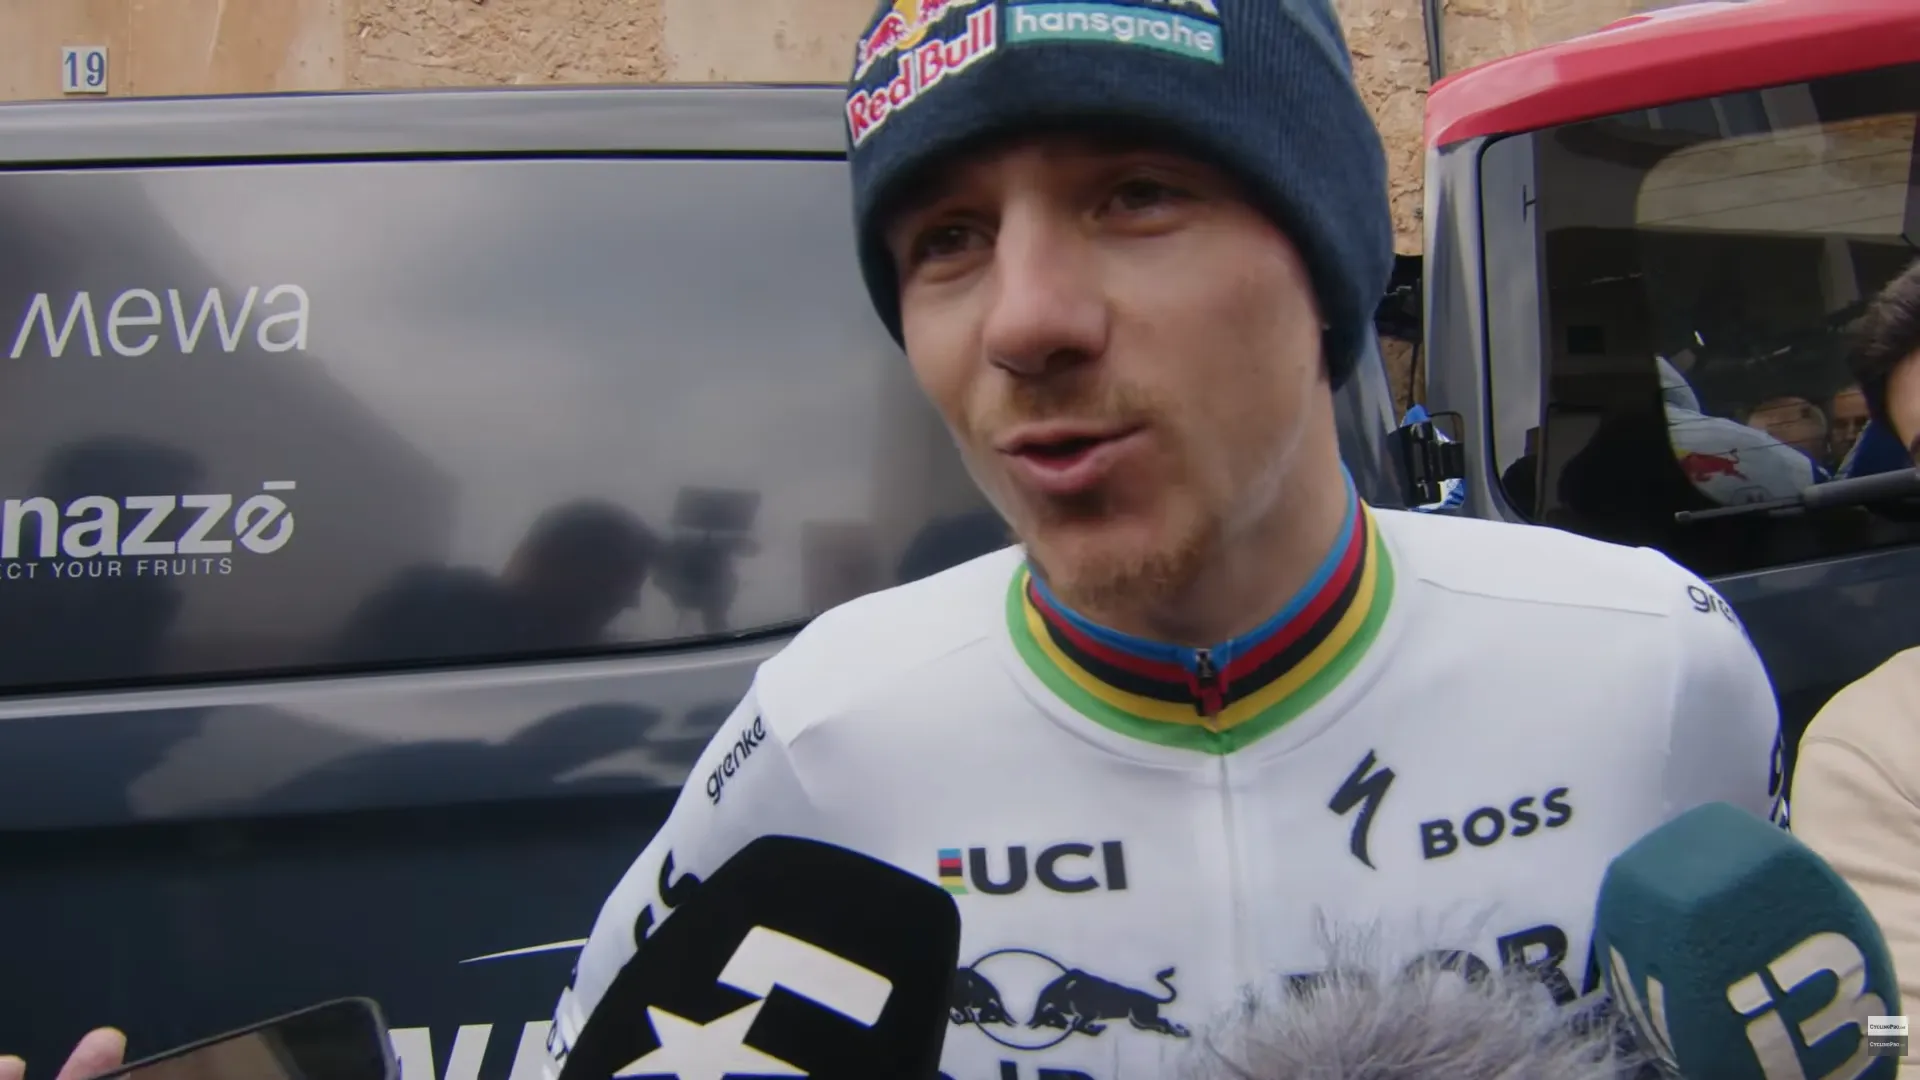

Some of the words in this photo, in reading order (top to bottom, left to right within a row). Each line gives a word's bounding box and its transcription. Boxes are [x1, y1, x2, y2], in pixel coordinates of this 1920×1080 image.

[1014, 5, 1214, 51] hansgrohe
[64, 51, 105, 88] 19
[847, 51, 917, 148] Red
[914, 4, 997, 94] Bull
[0, 562, 39, 580] CT
[52, 561, 122, 579] YOUR
[137, 557, 233, 576] FRUITS
[706, 714, 766, 806] grenke
[1420, 787, 1572, 860] BOSS
[968, 840, 1127, 895] UCI
